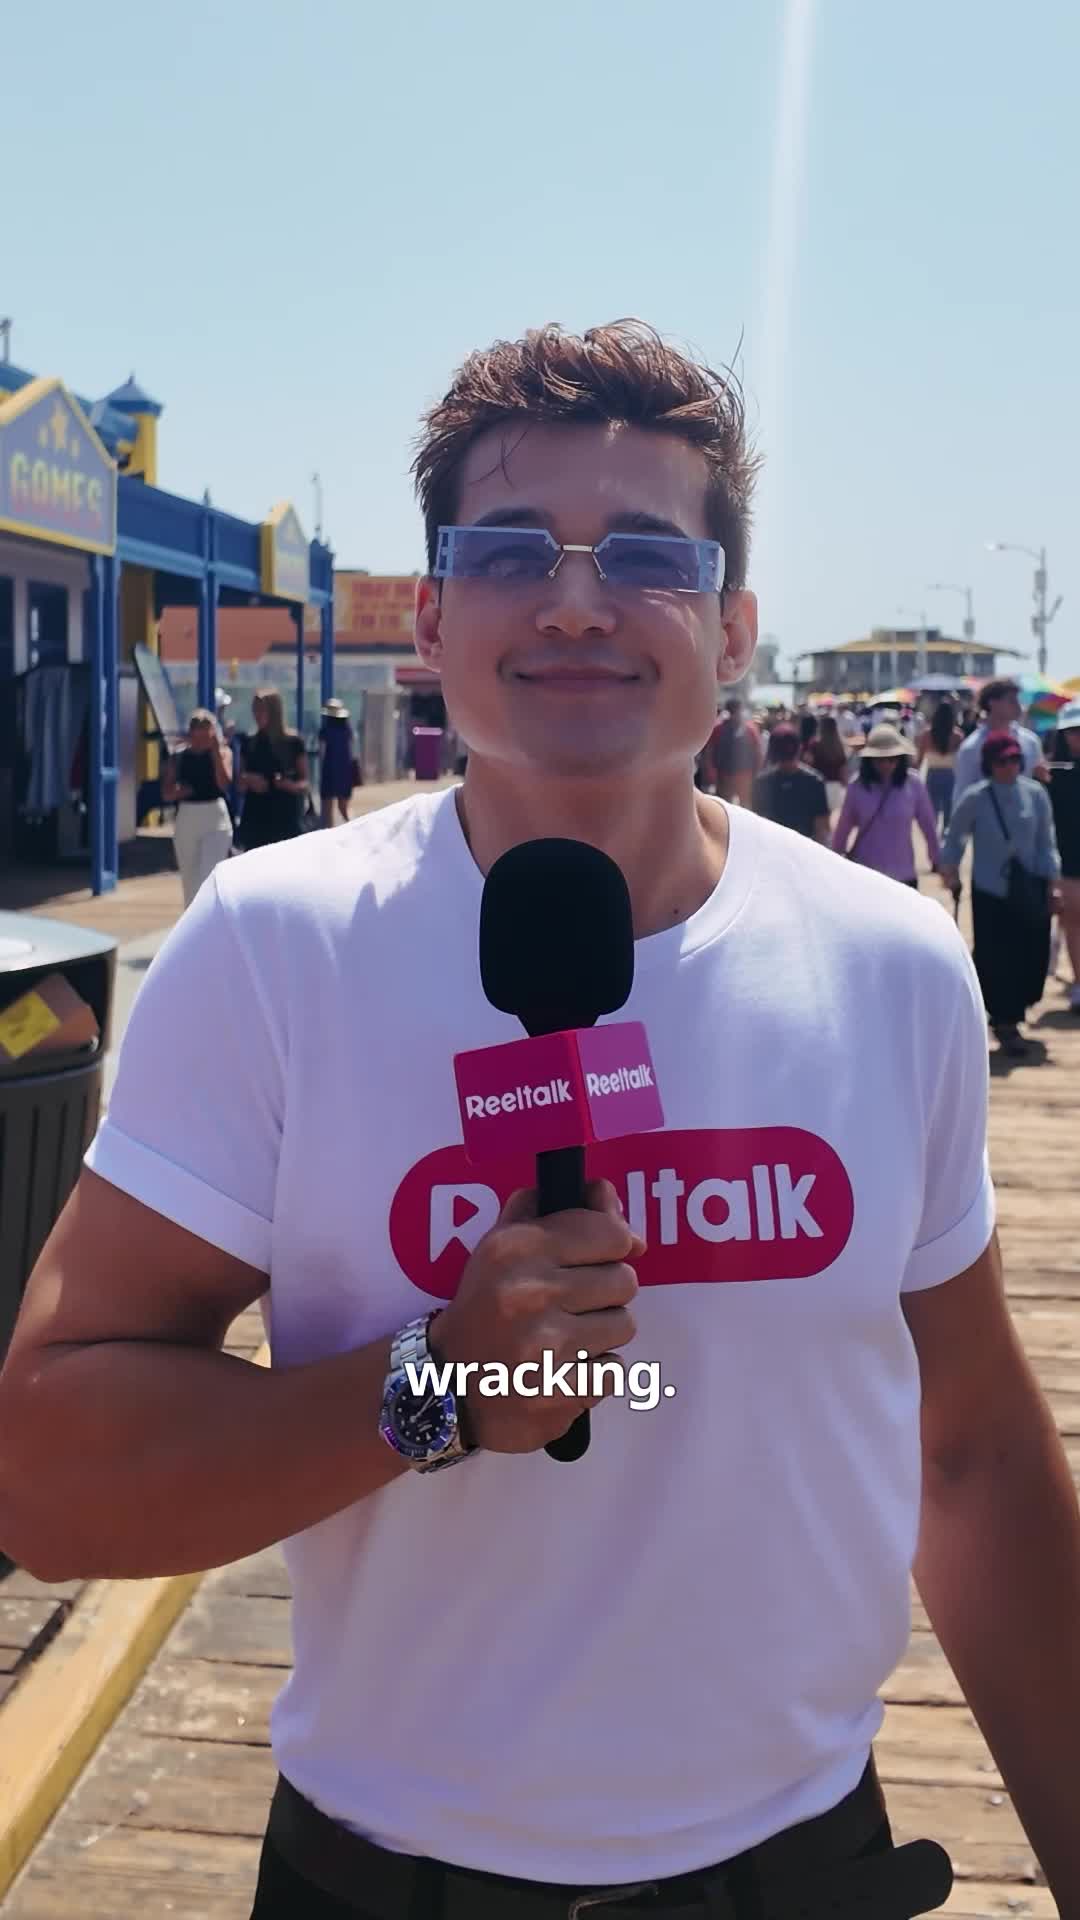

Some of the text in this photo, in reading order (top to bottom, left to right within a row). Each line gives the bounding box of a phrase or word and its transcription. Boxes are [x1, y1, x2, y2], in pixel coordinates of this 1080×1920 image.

[465, 1079, 573, 1119] Reeltalk
[586, 1064, 654, 1097] Reeltalk
[430, 1164, 824, 1263] Rltalk
